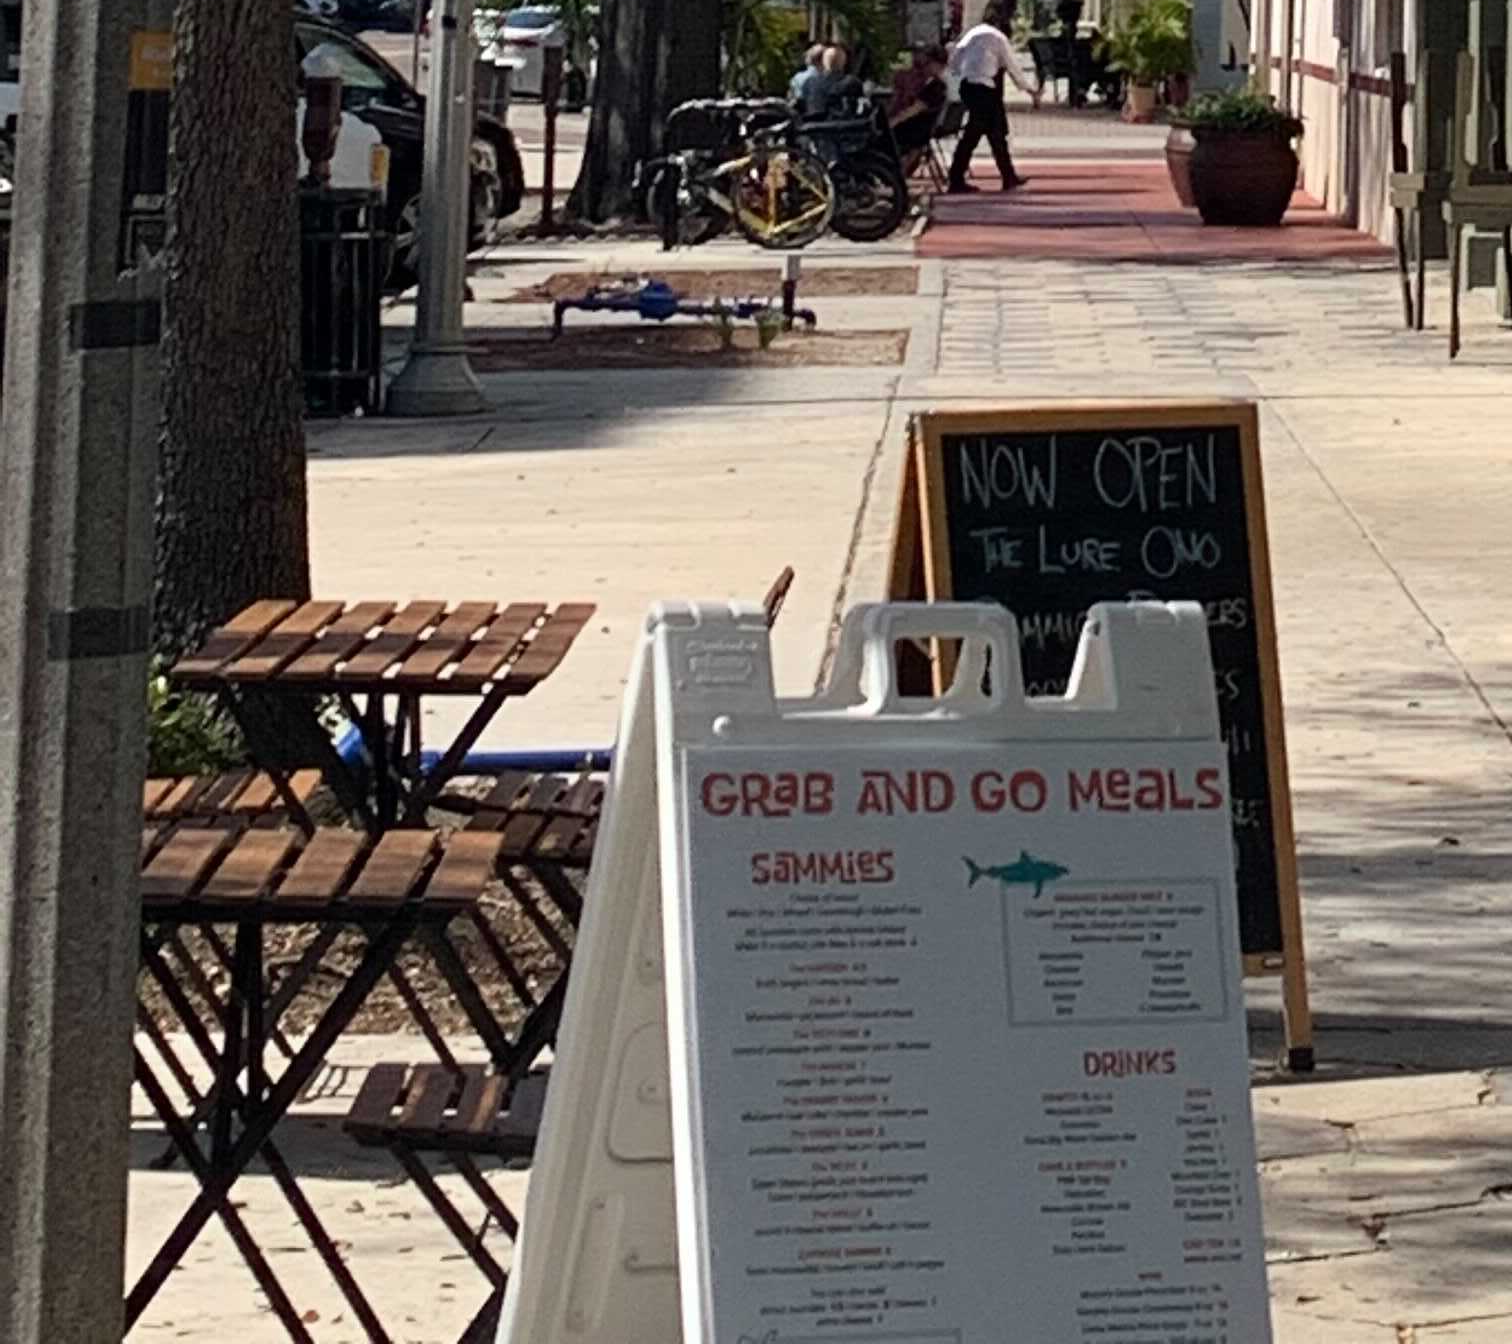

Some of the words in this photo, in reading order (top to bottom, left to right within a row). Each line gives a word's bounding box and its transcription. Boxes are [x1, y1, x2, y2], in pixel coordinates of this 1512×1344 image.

[960, 434, 1058, 509] NOW
[1093, 433, 1217, 512] OPEN
[857, 769, 956, 815] AND
[970, 769, 1048, 813] GO
